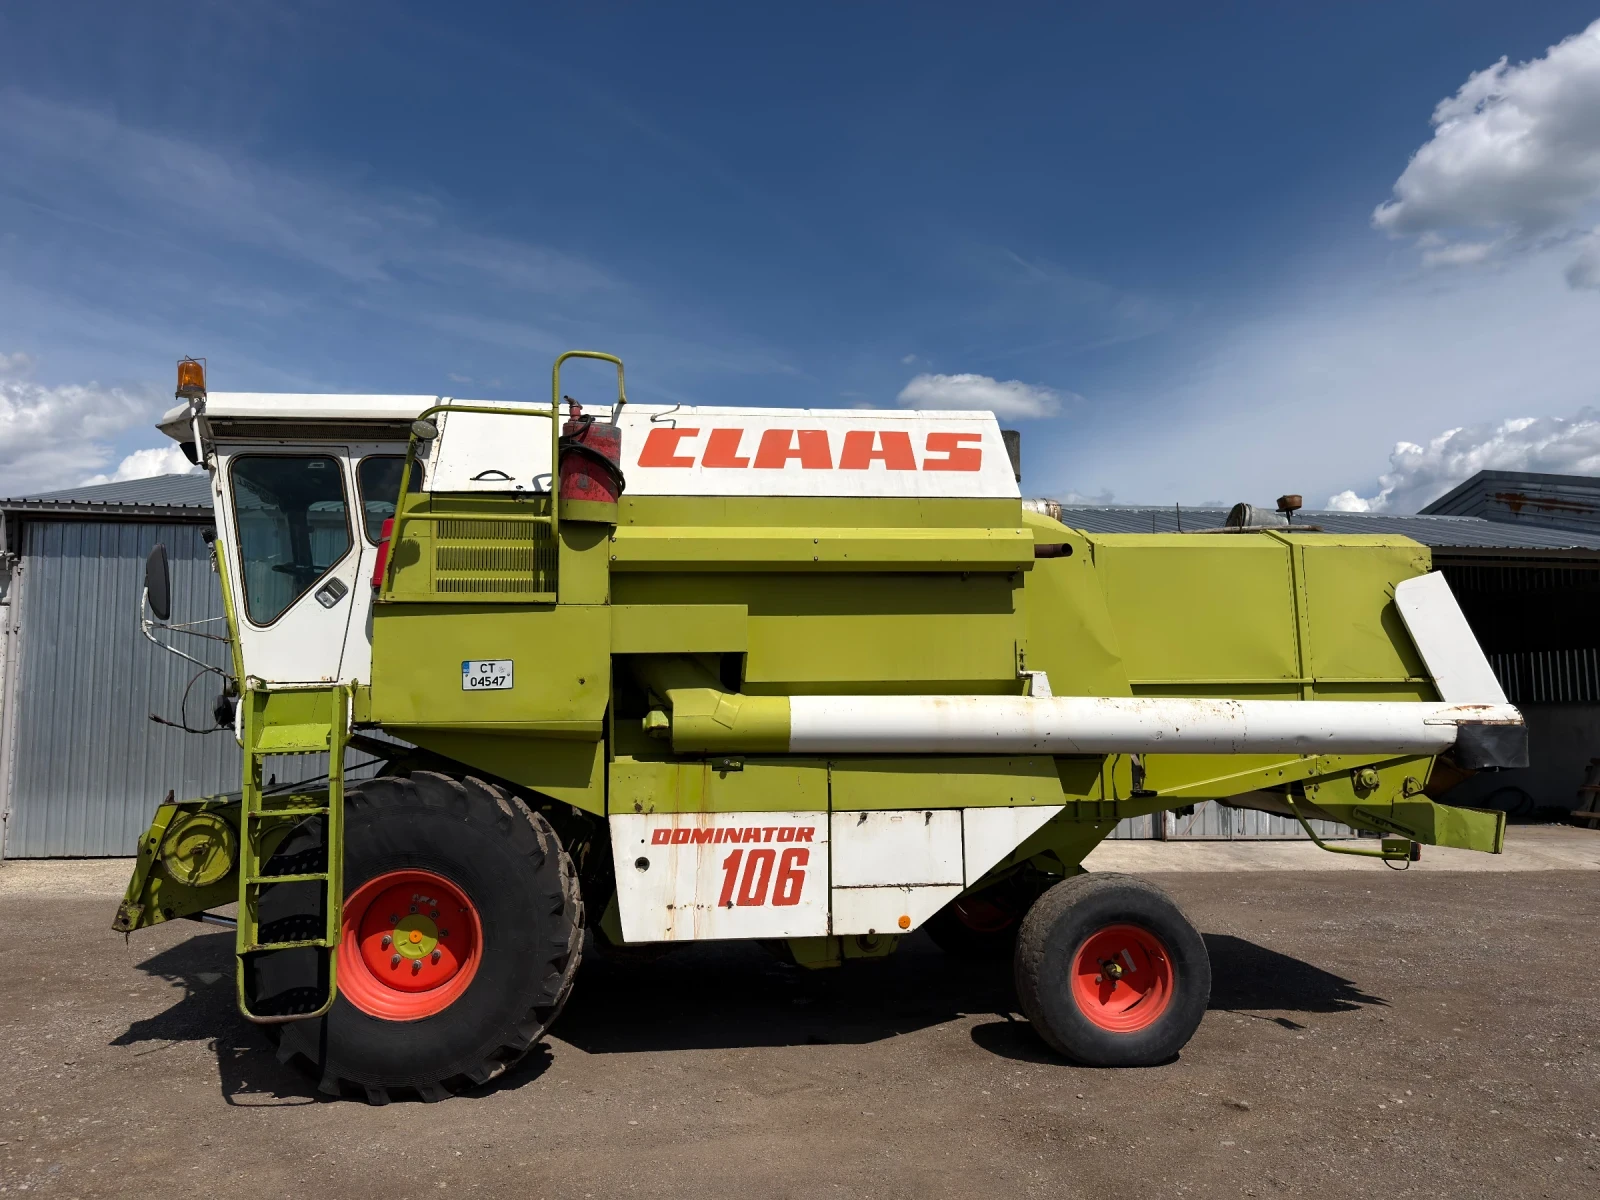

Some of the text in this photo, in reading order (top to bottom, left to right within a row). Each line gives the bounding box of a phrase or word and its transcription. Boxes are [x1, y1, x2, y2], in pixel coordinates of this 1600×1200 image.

[637, 428, 982, 471] CLAAS
[480, 663, 495, 673] CT
[470, 676, 506, 687] 04547
[651, 827, 815, 845] DOMINATOR
[718, 848, 810, 907] 106
